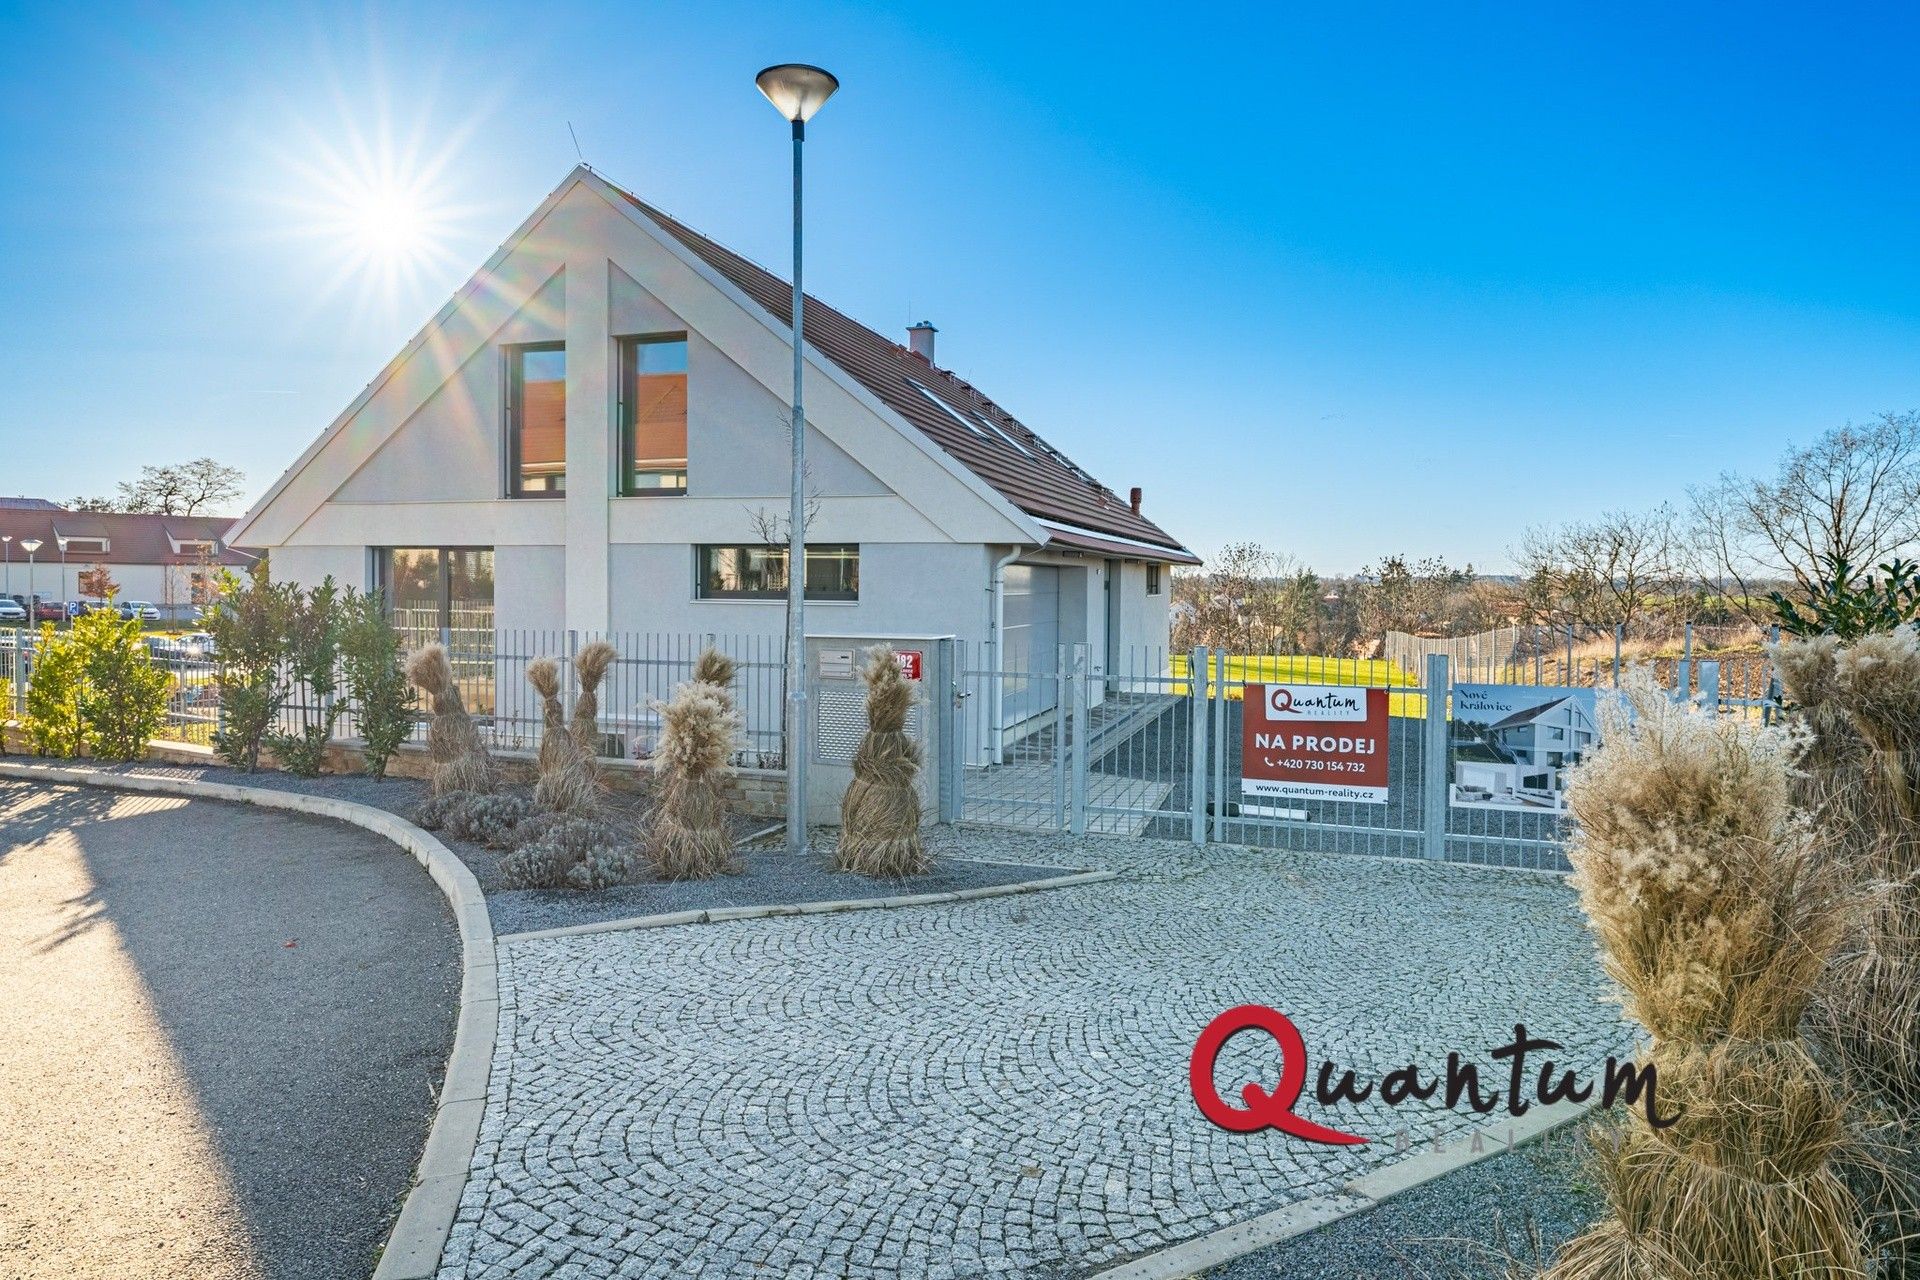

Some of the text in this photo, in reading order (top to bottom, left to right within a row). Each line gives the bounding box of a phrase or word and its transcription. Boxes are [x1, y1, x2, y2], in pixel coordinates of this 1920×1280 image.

[1271, 688, 1360, 714] Quantum
[1460, 690, 1488, 700] Nové
[1460, 701, 1513, 712] Královice
[1255, 733, 1375, 755] NA PRODEJ
[1277, 759, 1366, 773] +420 730 154 732
[1255, 784, 1374, 799] www.quantum-reality.cz
